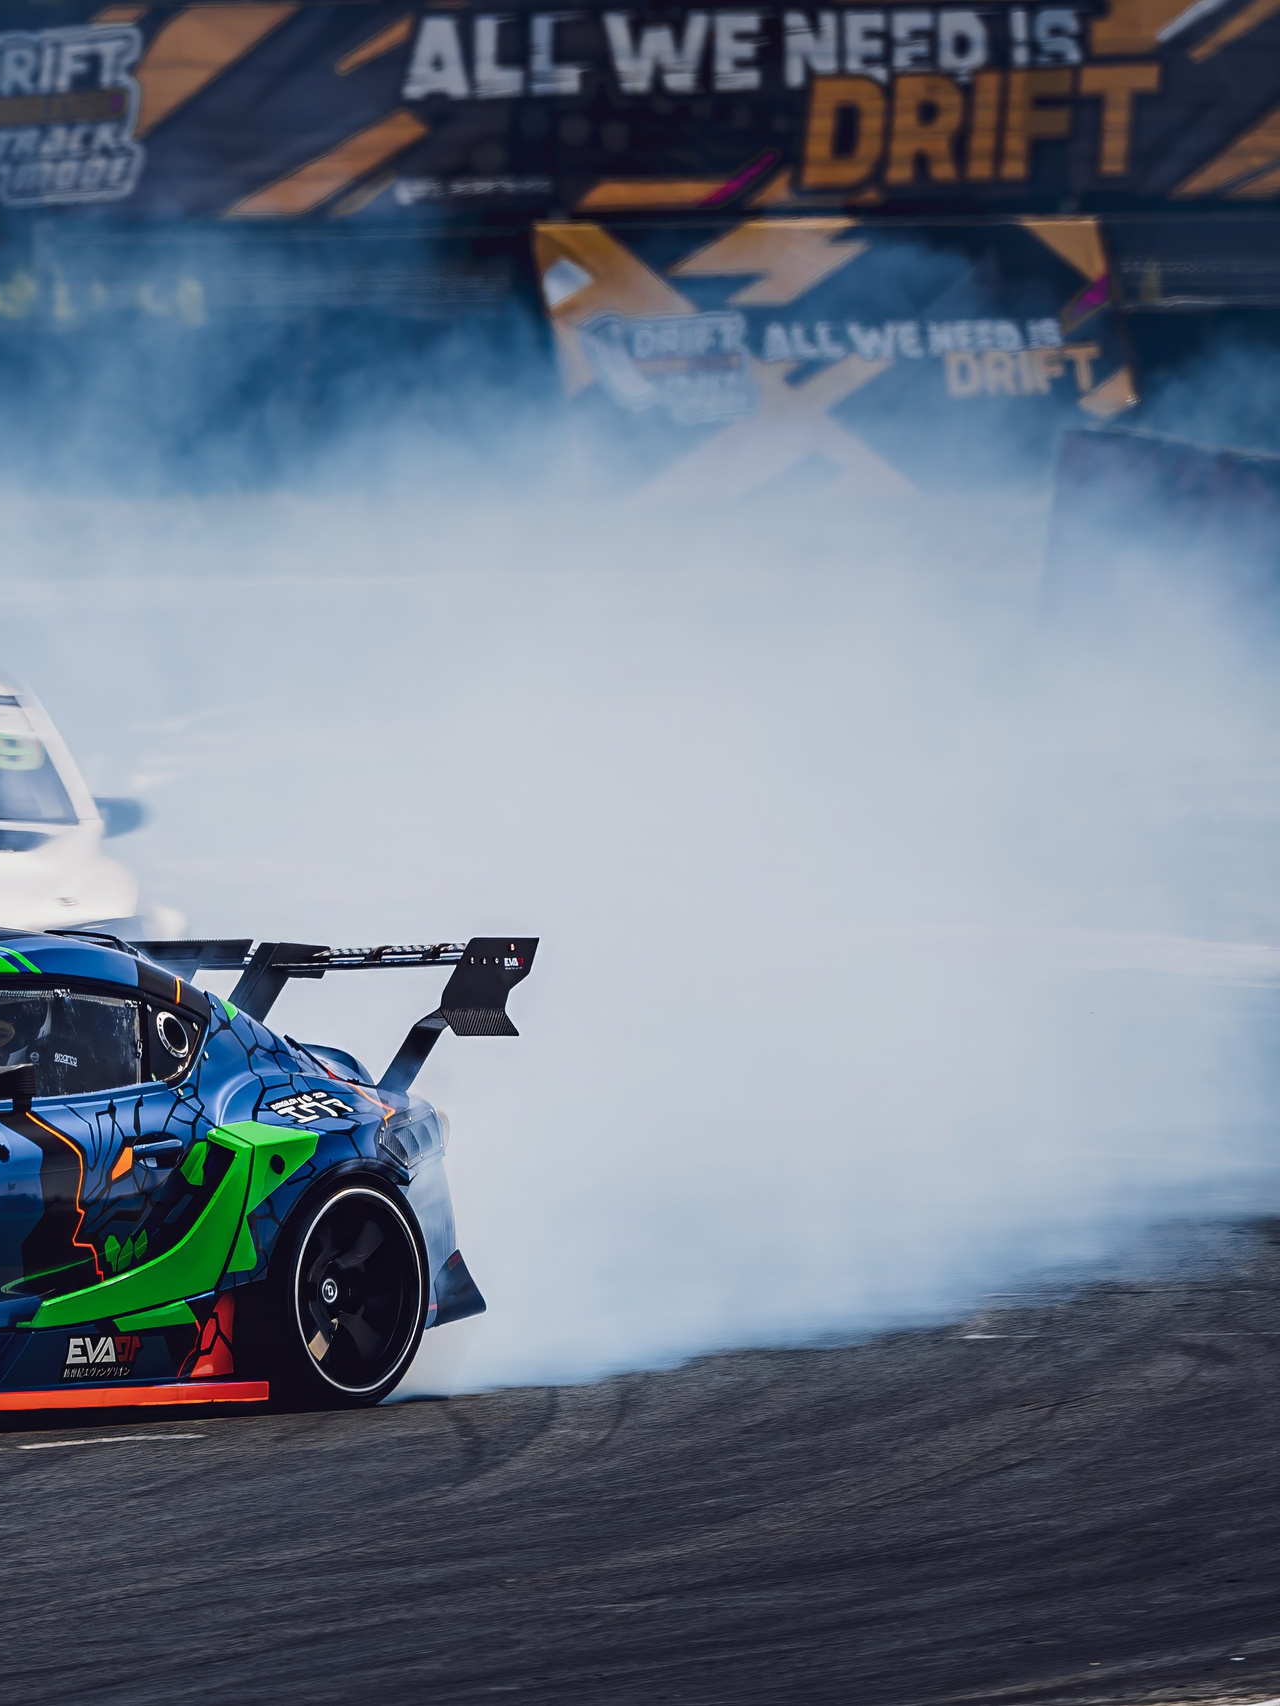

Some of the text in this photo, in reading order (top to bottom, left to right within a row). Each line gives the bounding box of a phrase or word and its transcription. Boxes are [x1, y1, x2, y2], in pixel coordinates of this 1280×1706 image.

[402, 8, 1083, 100] ALL WE NEED IS
[801, 64, 1161, 188] DRIFT
[763, 320, 846, 362] ALL
[847, 318, 923, 359] WE
[945, 346, 1099, 397] DRIFT
